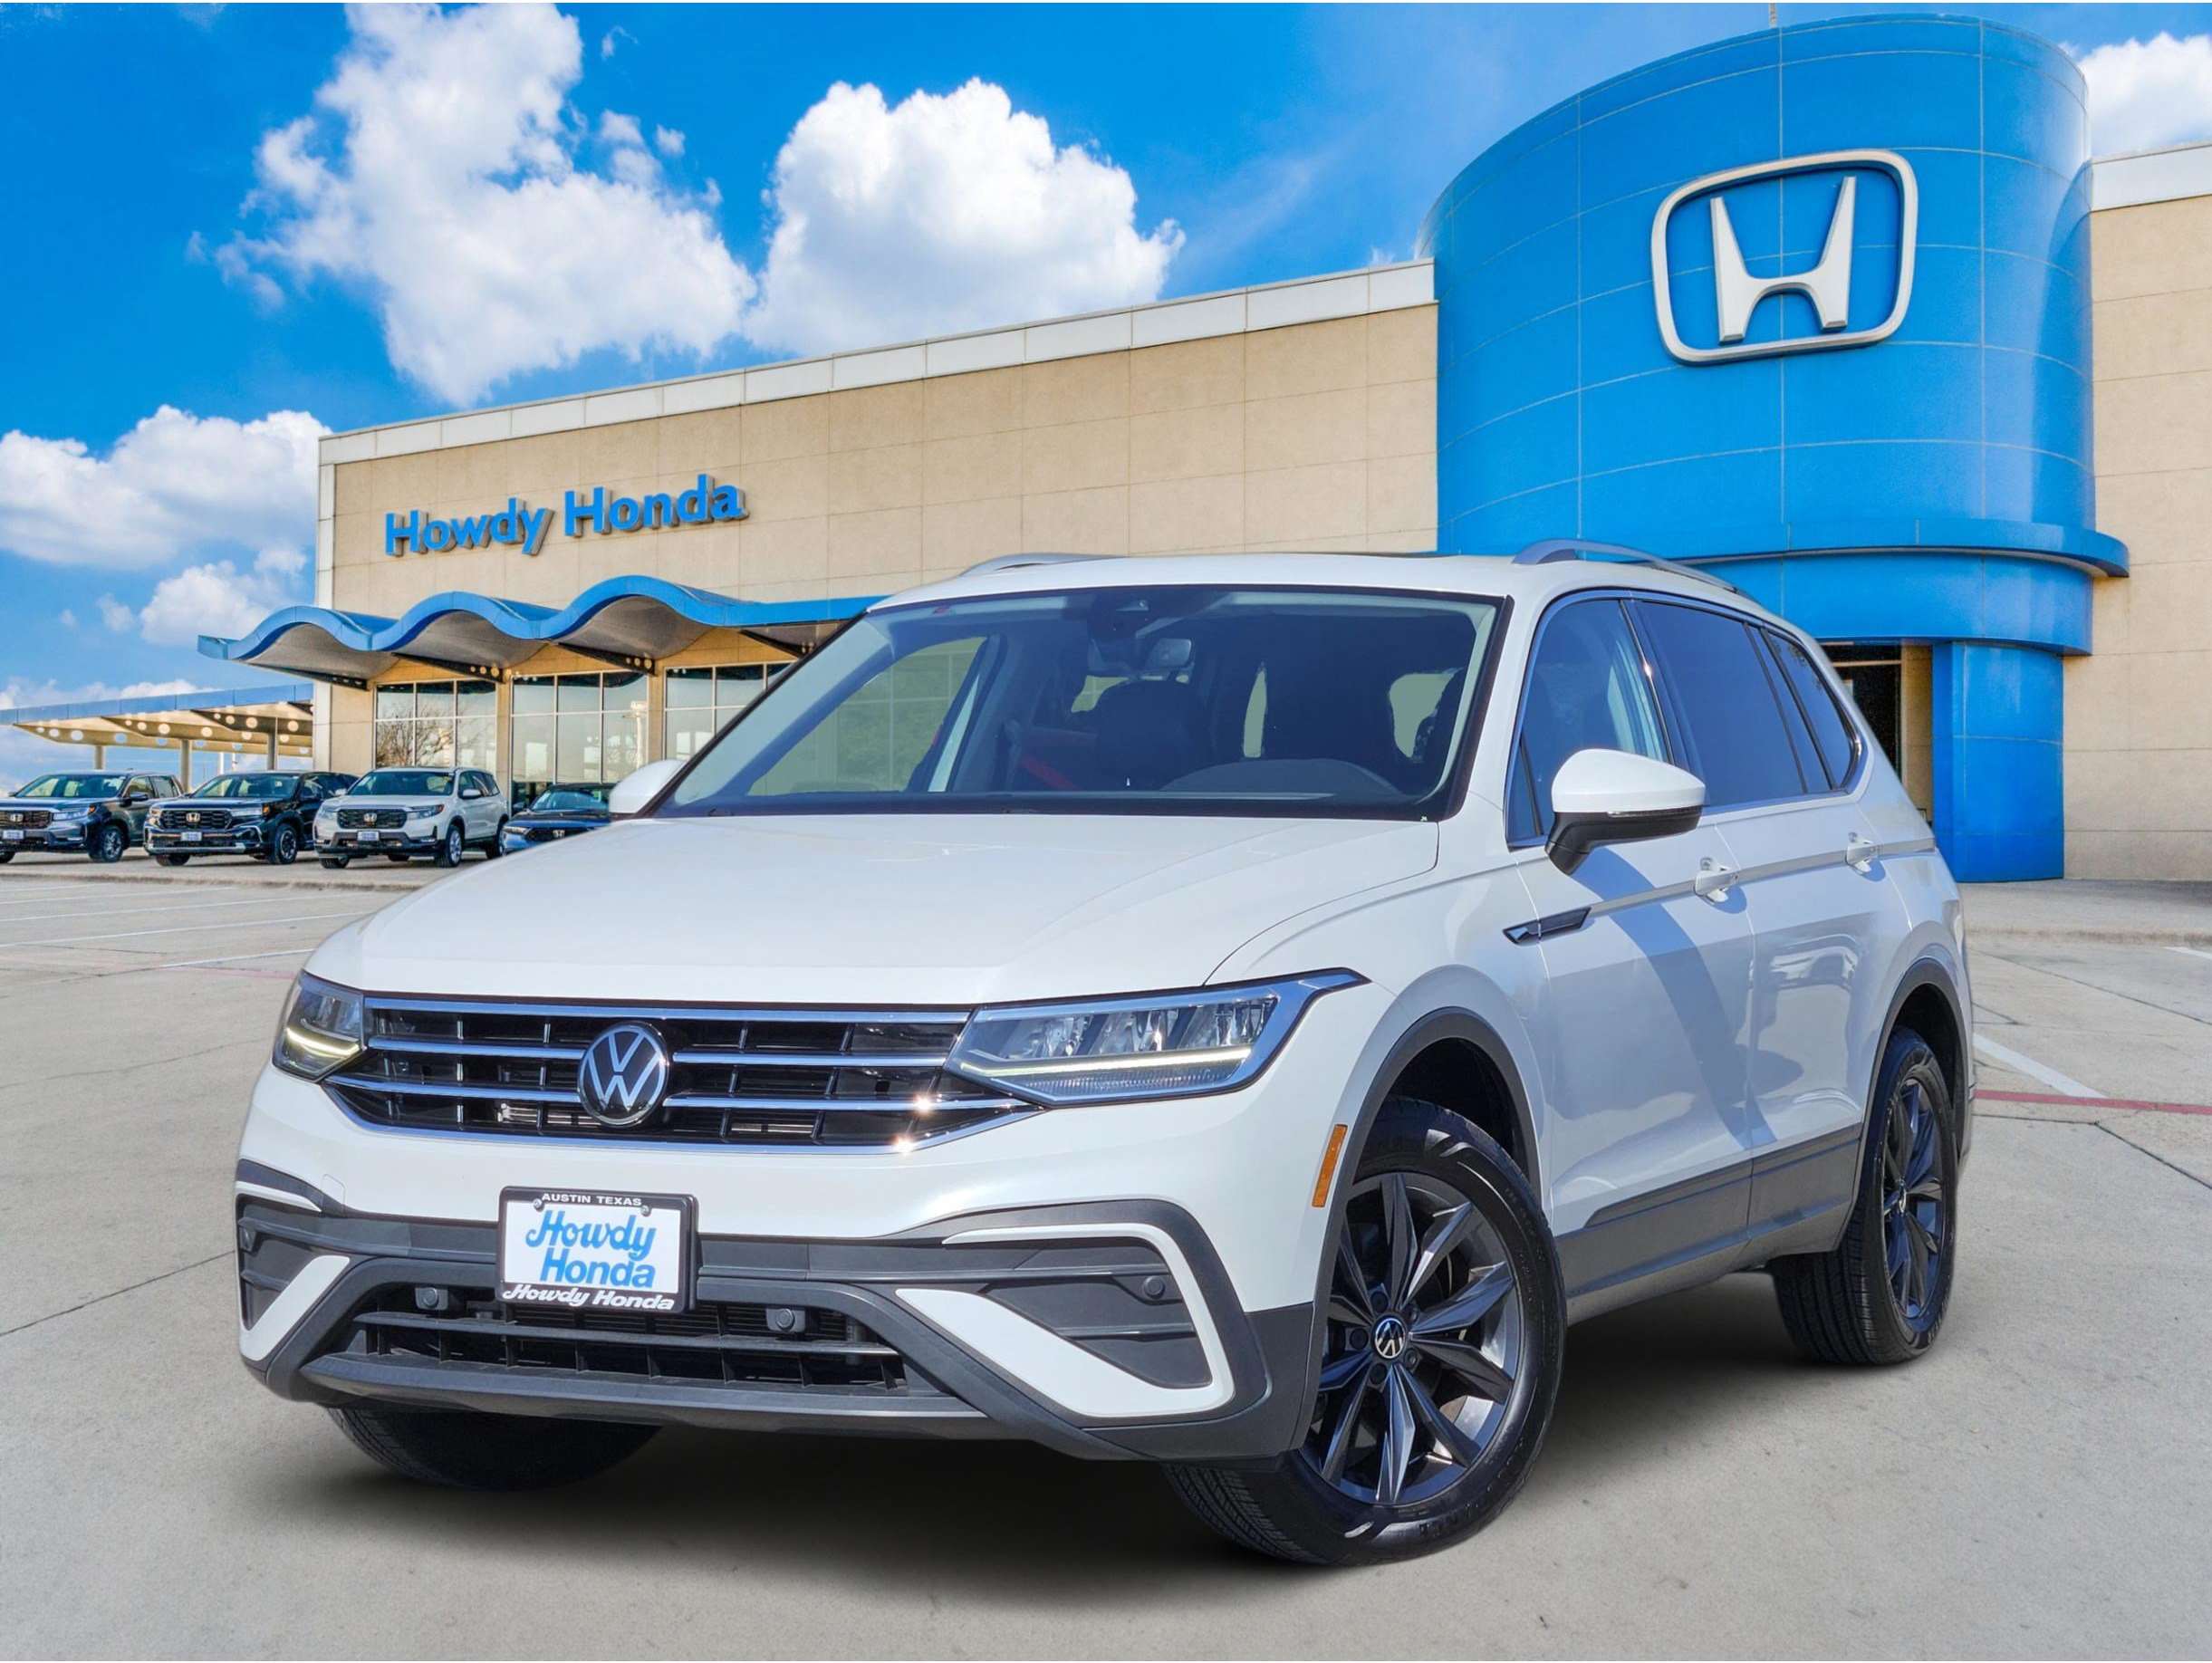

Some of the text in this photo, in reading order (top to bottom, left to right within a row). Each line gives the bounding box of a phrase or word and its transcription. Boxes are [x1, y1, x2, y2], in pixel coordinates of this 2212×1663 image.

[385, 474, 747, 555] Howdy Honda
[542, 1193, 642, 1206] AUSTIN TEXAS
[525, 1210, 657, 1261] Howdy
[539, 1247, 656, 1288] Honda
[502, 1283, 675, 1311] Howdy Honda
